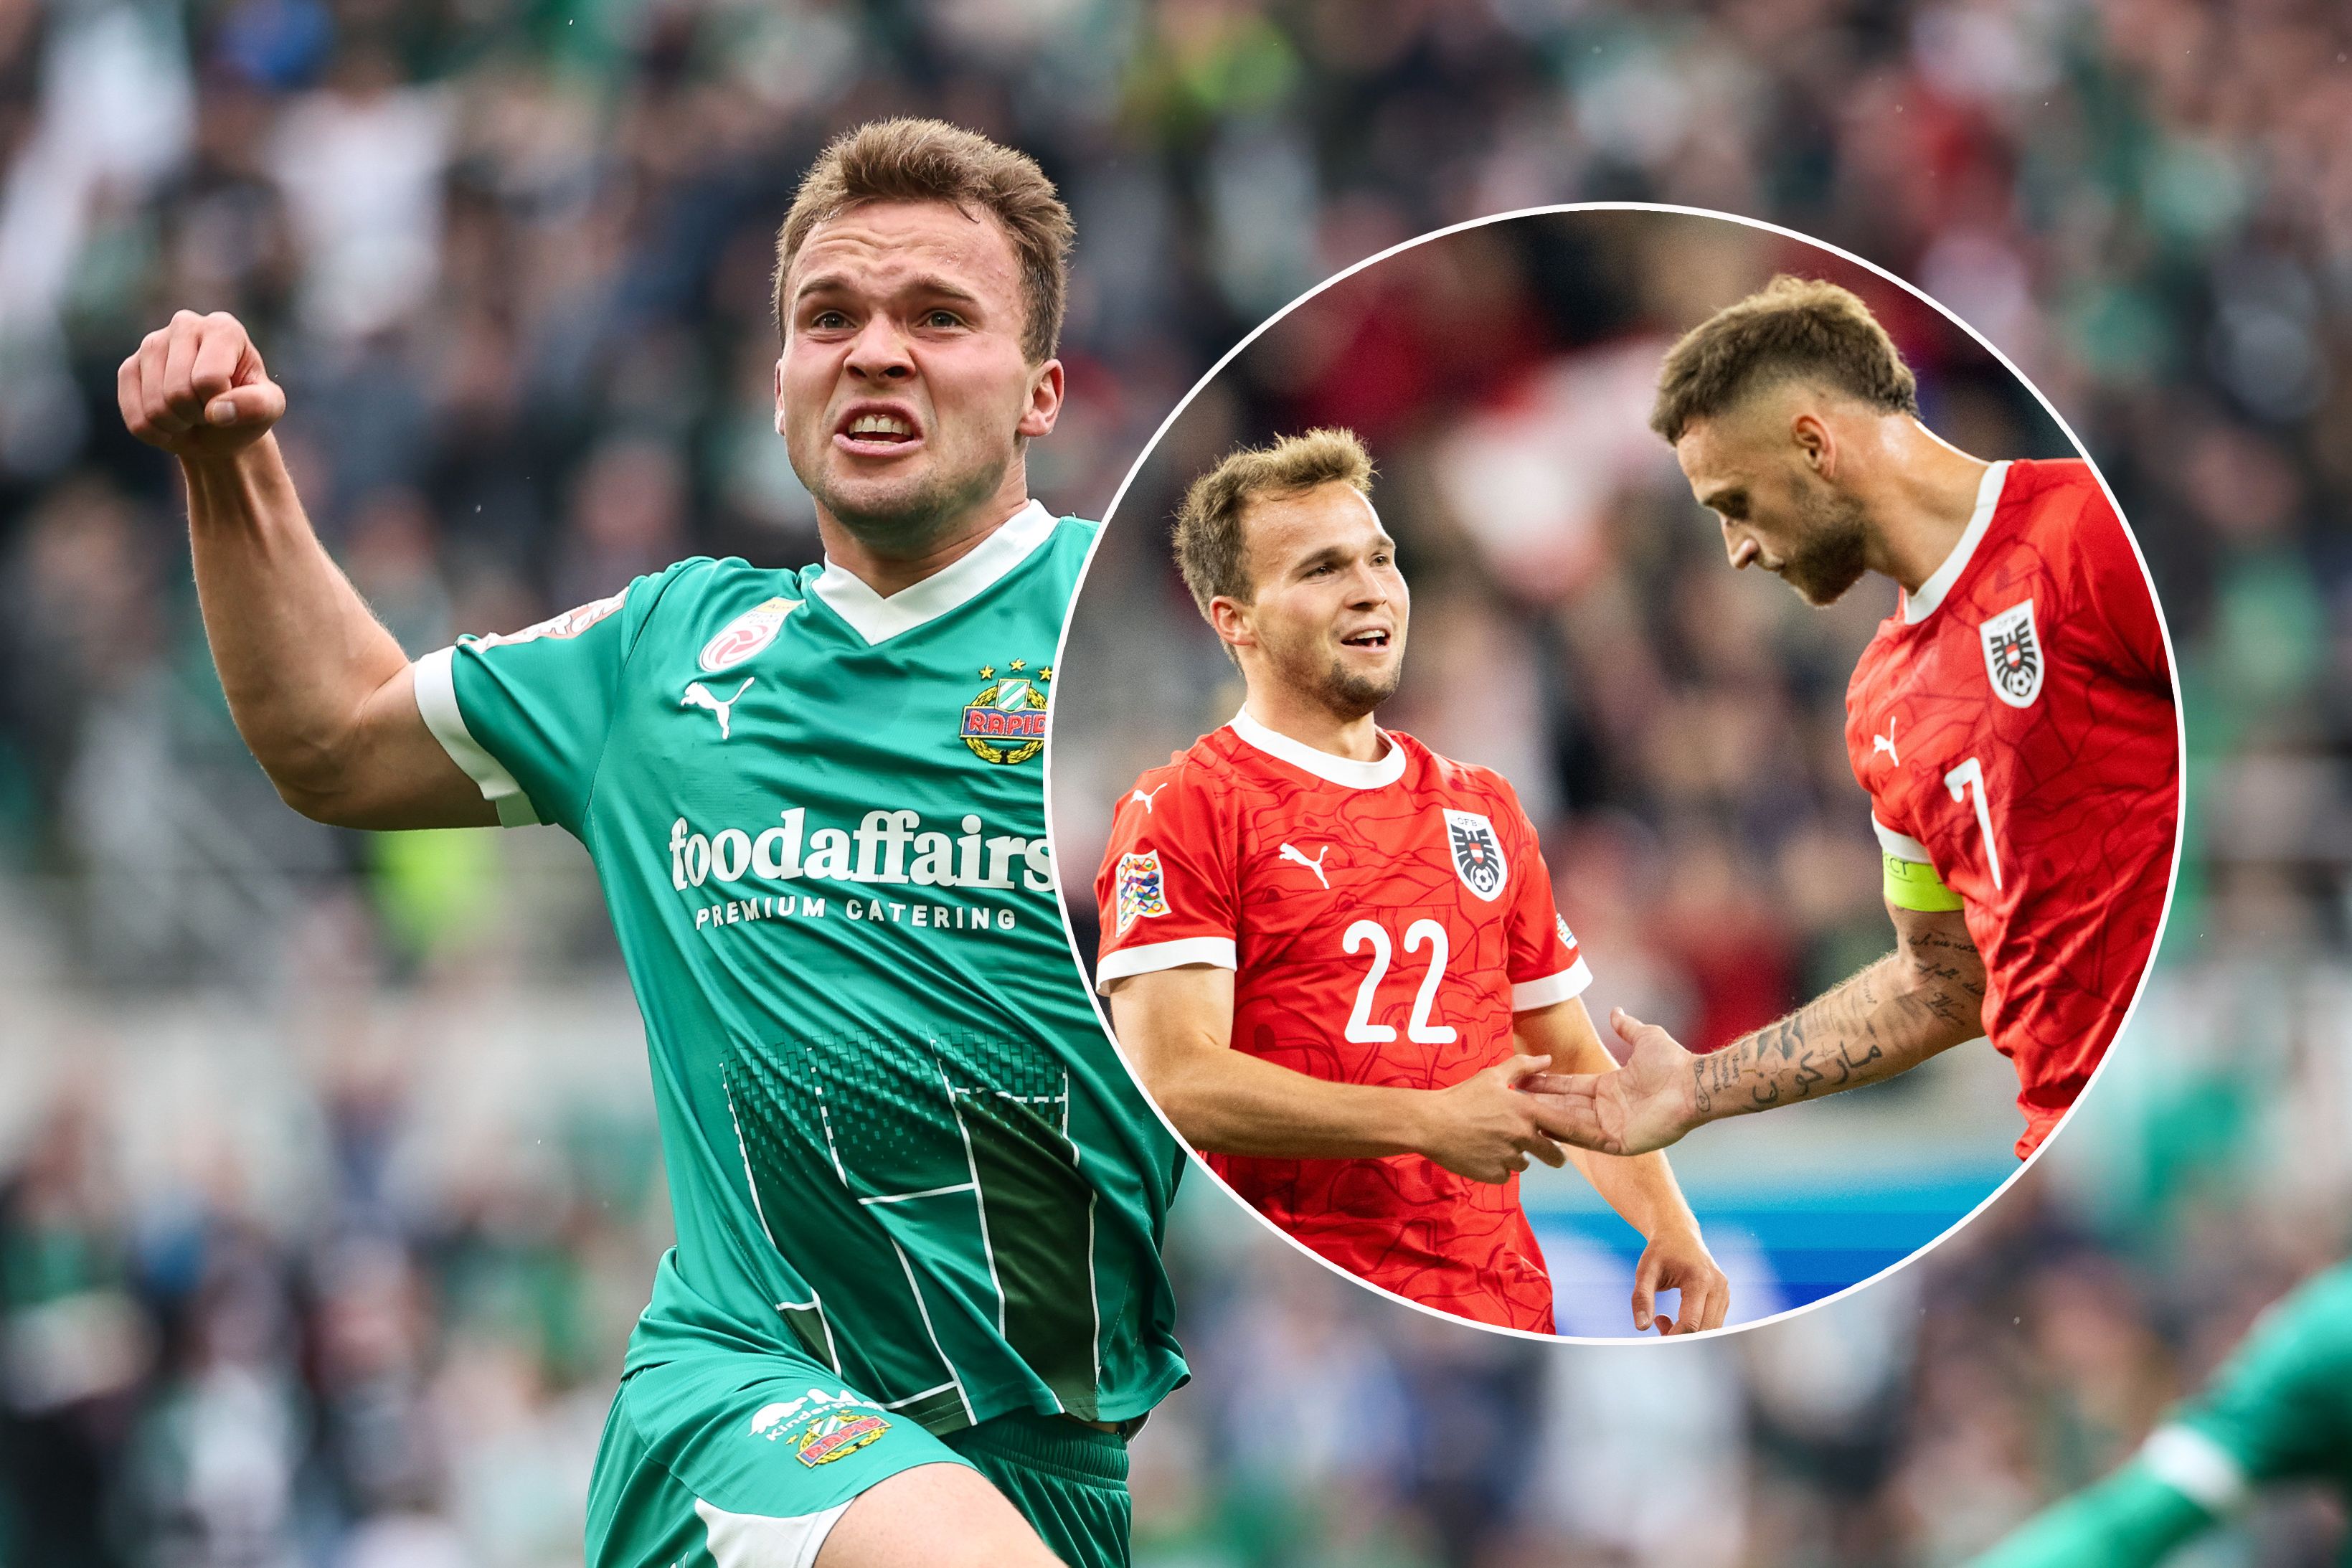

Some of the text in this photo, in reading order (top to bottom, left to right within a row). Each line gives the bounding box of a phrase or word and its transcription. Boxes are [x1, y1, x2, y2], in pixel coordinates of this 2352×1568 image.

[968, 709, 1047, 735] RAPID
[669, 807, 1055, 892] foodaffairs
[1944, 757, 2002, 891] 7
[696, 895, 1016, 930] PREMIUM CATERING
[1342, 919, 1457, 1044] 22
[804, 1418, 882, 1459] RAPID
